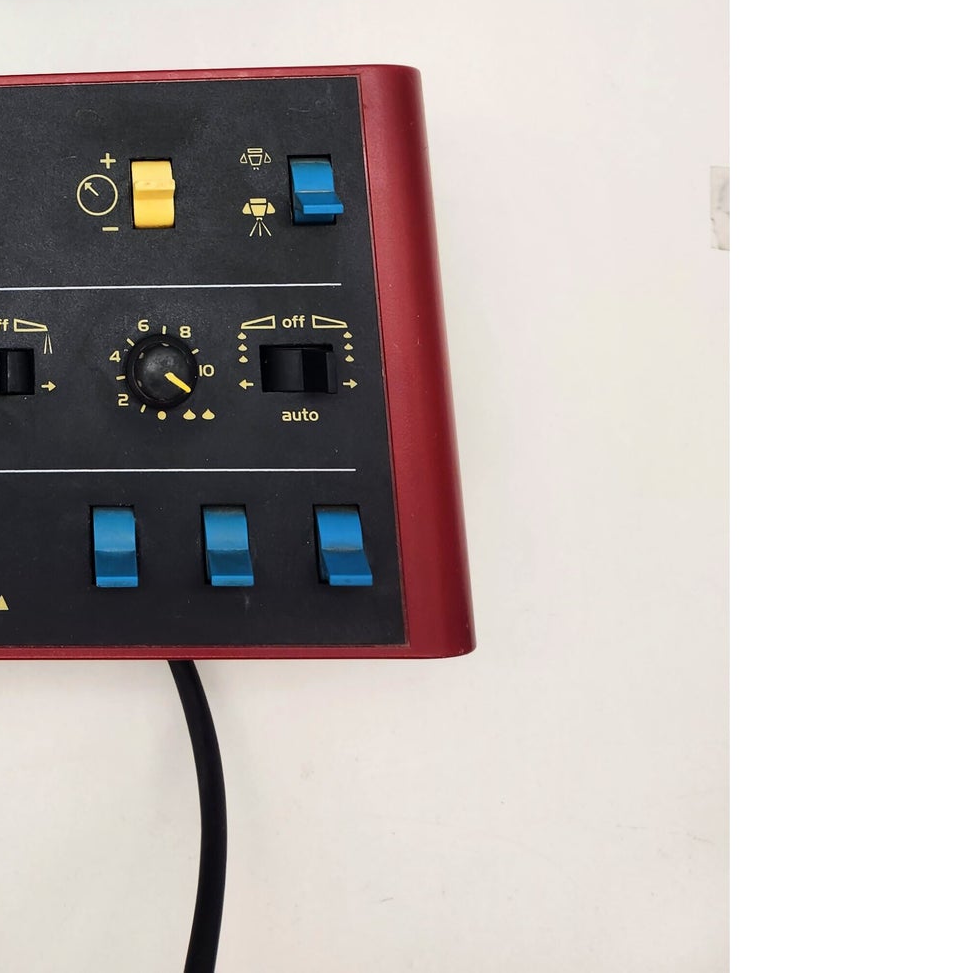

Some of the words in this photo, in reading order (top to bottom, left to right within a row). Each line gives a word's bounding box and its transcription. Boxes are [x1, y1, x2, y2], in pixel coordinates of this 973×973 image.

[137, 319, 149, 332] 6
[282, 314, 306, 329] off
[179, 325, 192, 339] 8
[109, 349, 121, 363] 4
[198, 364, 215, 378] 10
[117, 393, 129, 407] 2
[281, 408, 320, 423] auto
